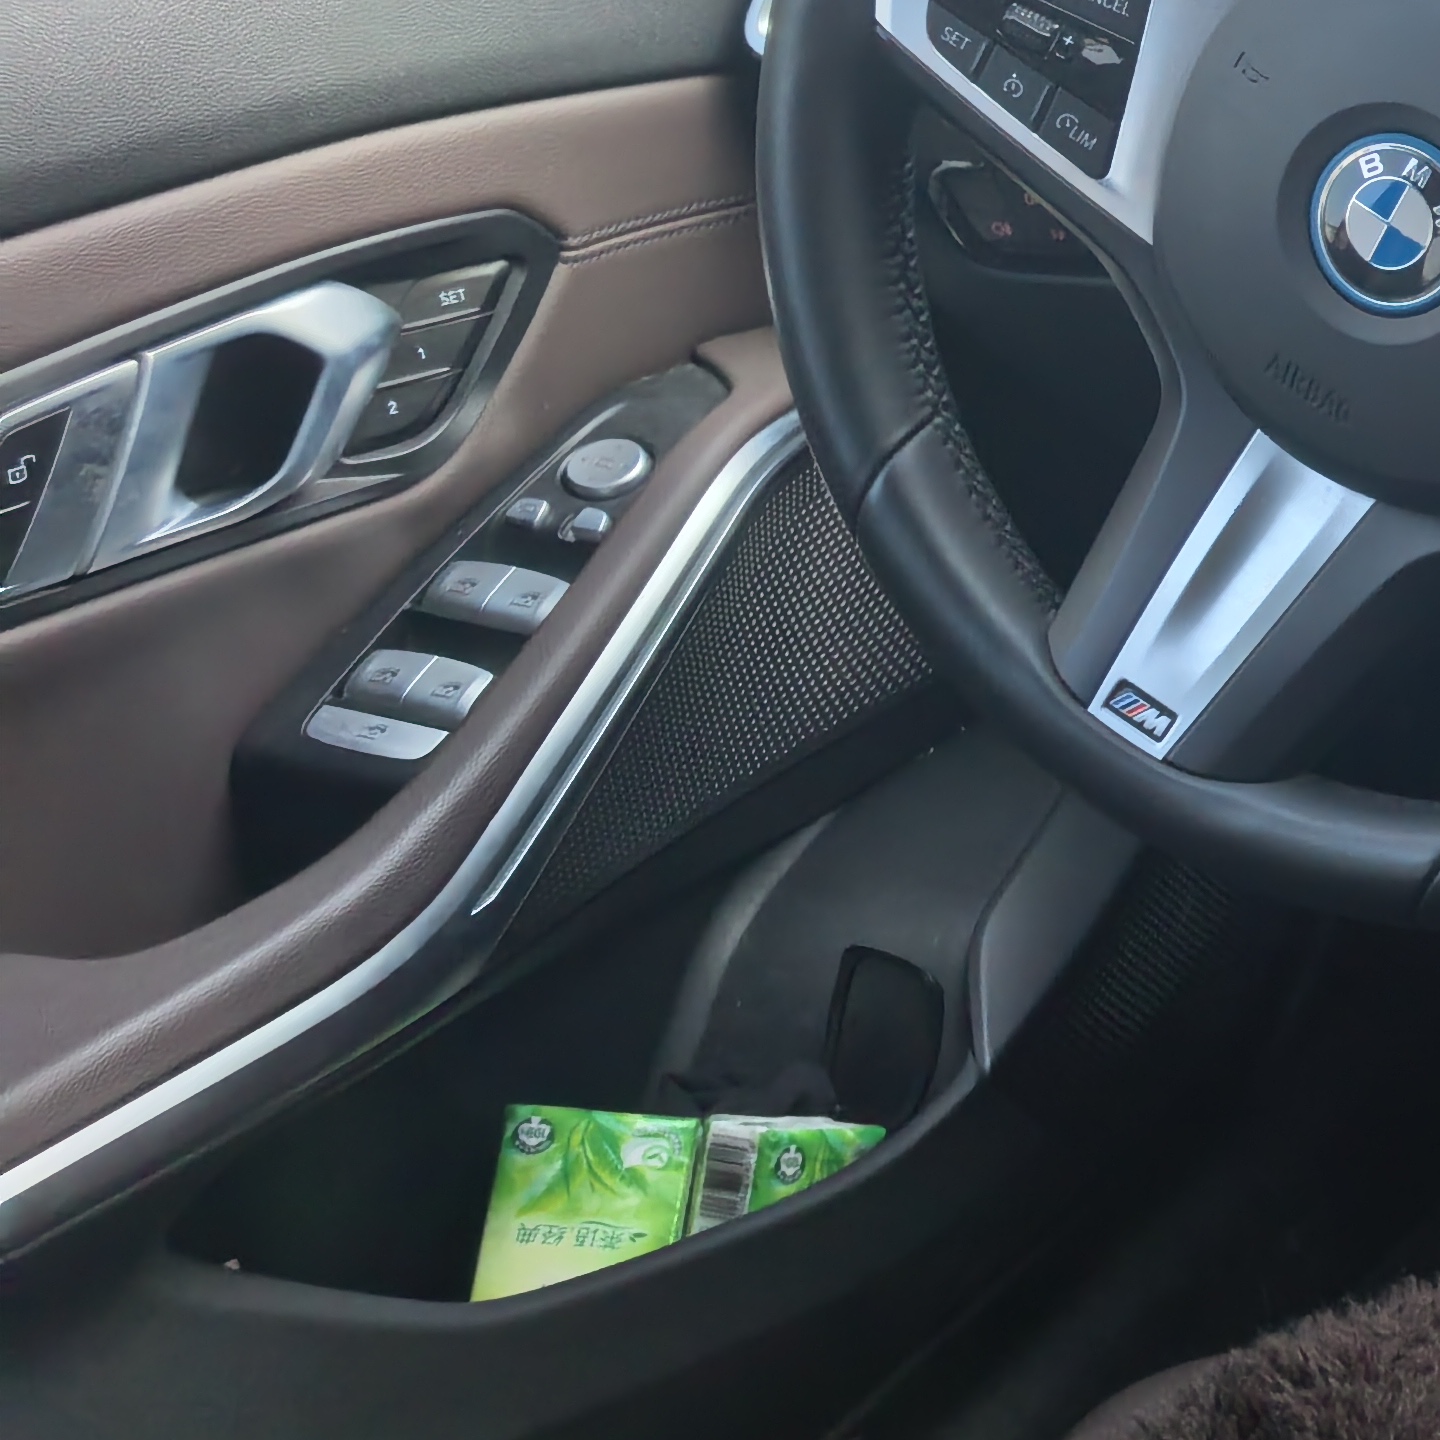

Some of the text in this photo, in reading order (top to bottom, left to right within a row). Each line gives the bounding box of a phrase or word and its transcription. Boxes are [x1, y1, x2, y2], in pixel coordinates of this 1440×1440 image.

[940, 26, 973, 51] SET
[1068, 125, 1098, 151] LIM
[439, 288, 466, 307] SET
[416, 346, 426, 360] 1
[387, 400, 399, 415] 2
